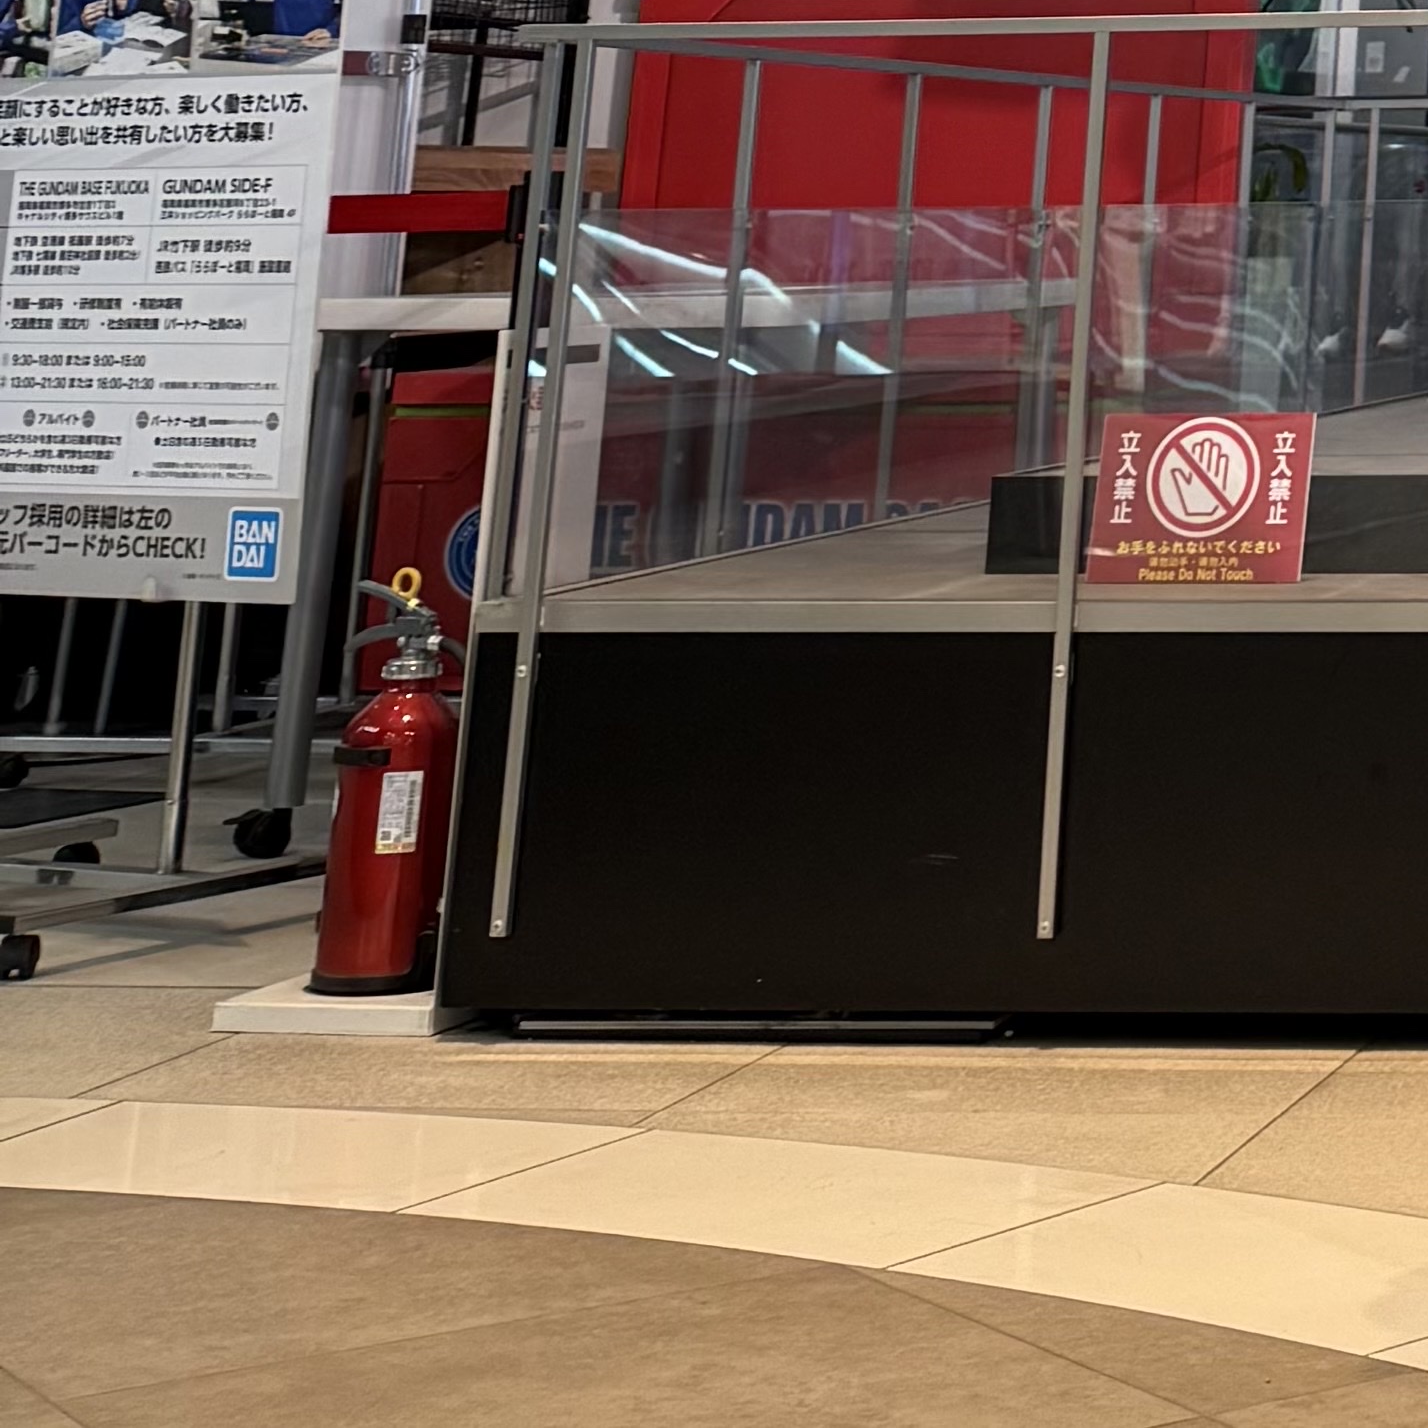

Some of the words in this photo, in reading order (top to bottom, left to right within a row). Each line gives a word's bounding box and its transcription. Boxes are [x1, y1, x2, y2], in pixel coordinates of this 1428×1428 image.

[37, 180, 80, 197] GUNDAM
[81, 179, 105, 196] BASE
[162, 178, 227, 195] GUNDAM
[229, 177, 274, 194] SIDE-F
[1109, 430, 1141, 524] 立入禁止
[1265, 430, 1297, 525] 立入禁止
[233, 519, 275, 545] BAN
[231, 544, 266, 569] DAI
[1116, 539, 1282, 556] お手をふれないでください
[1138, 567, 1175, 582] Please
[1178, 567, 1193, 581] Do
[1196, 567, 1217, 581] Not
[1220, 567, 1254, 581] Touch
